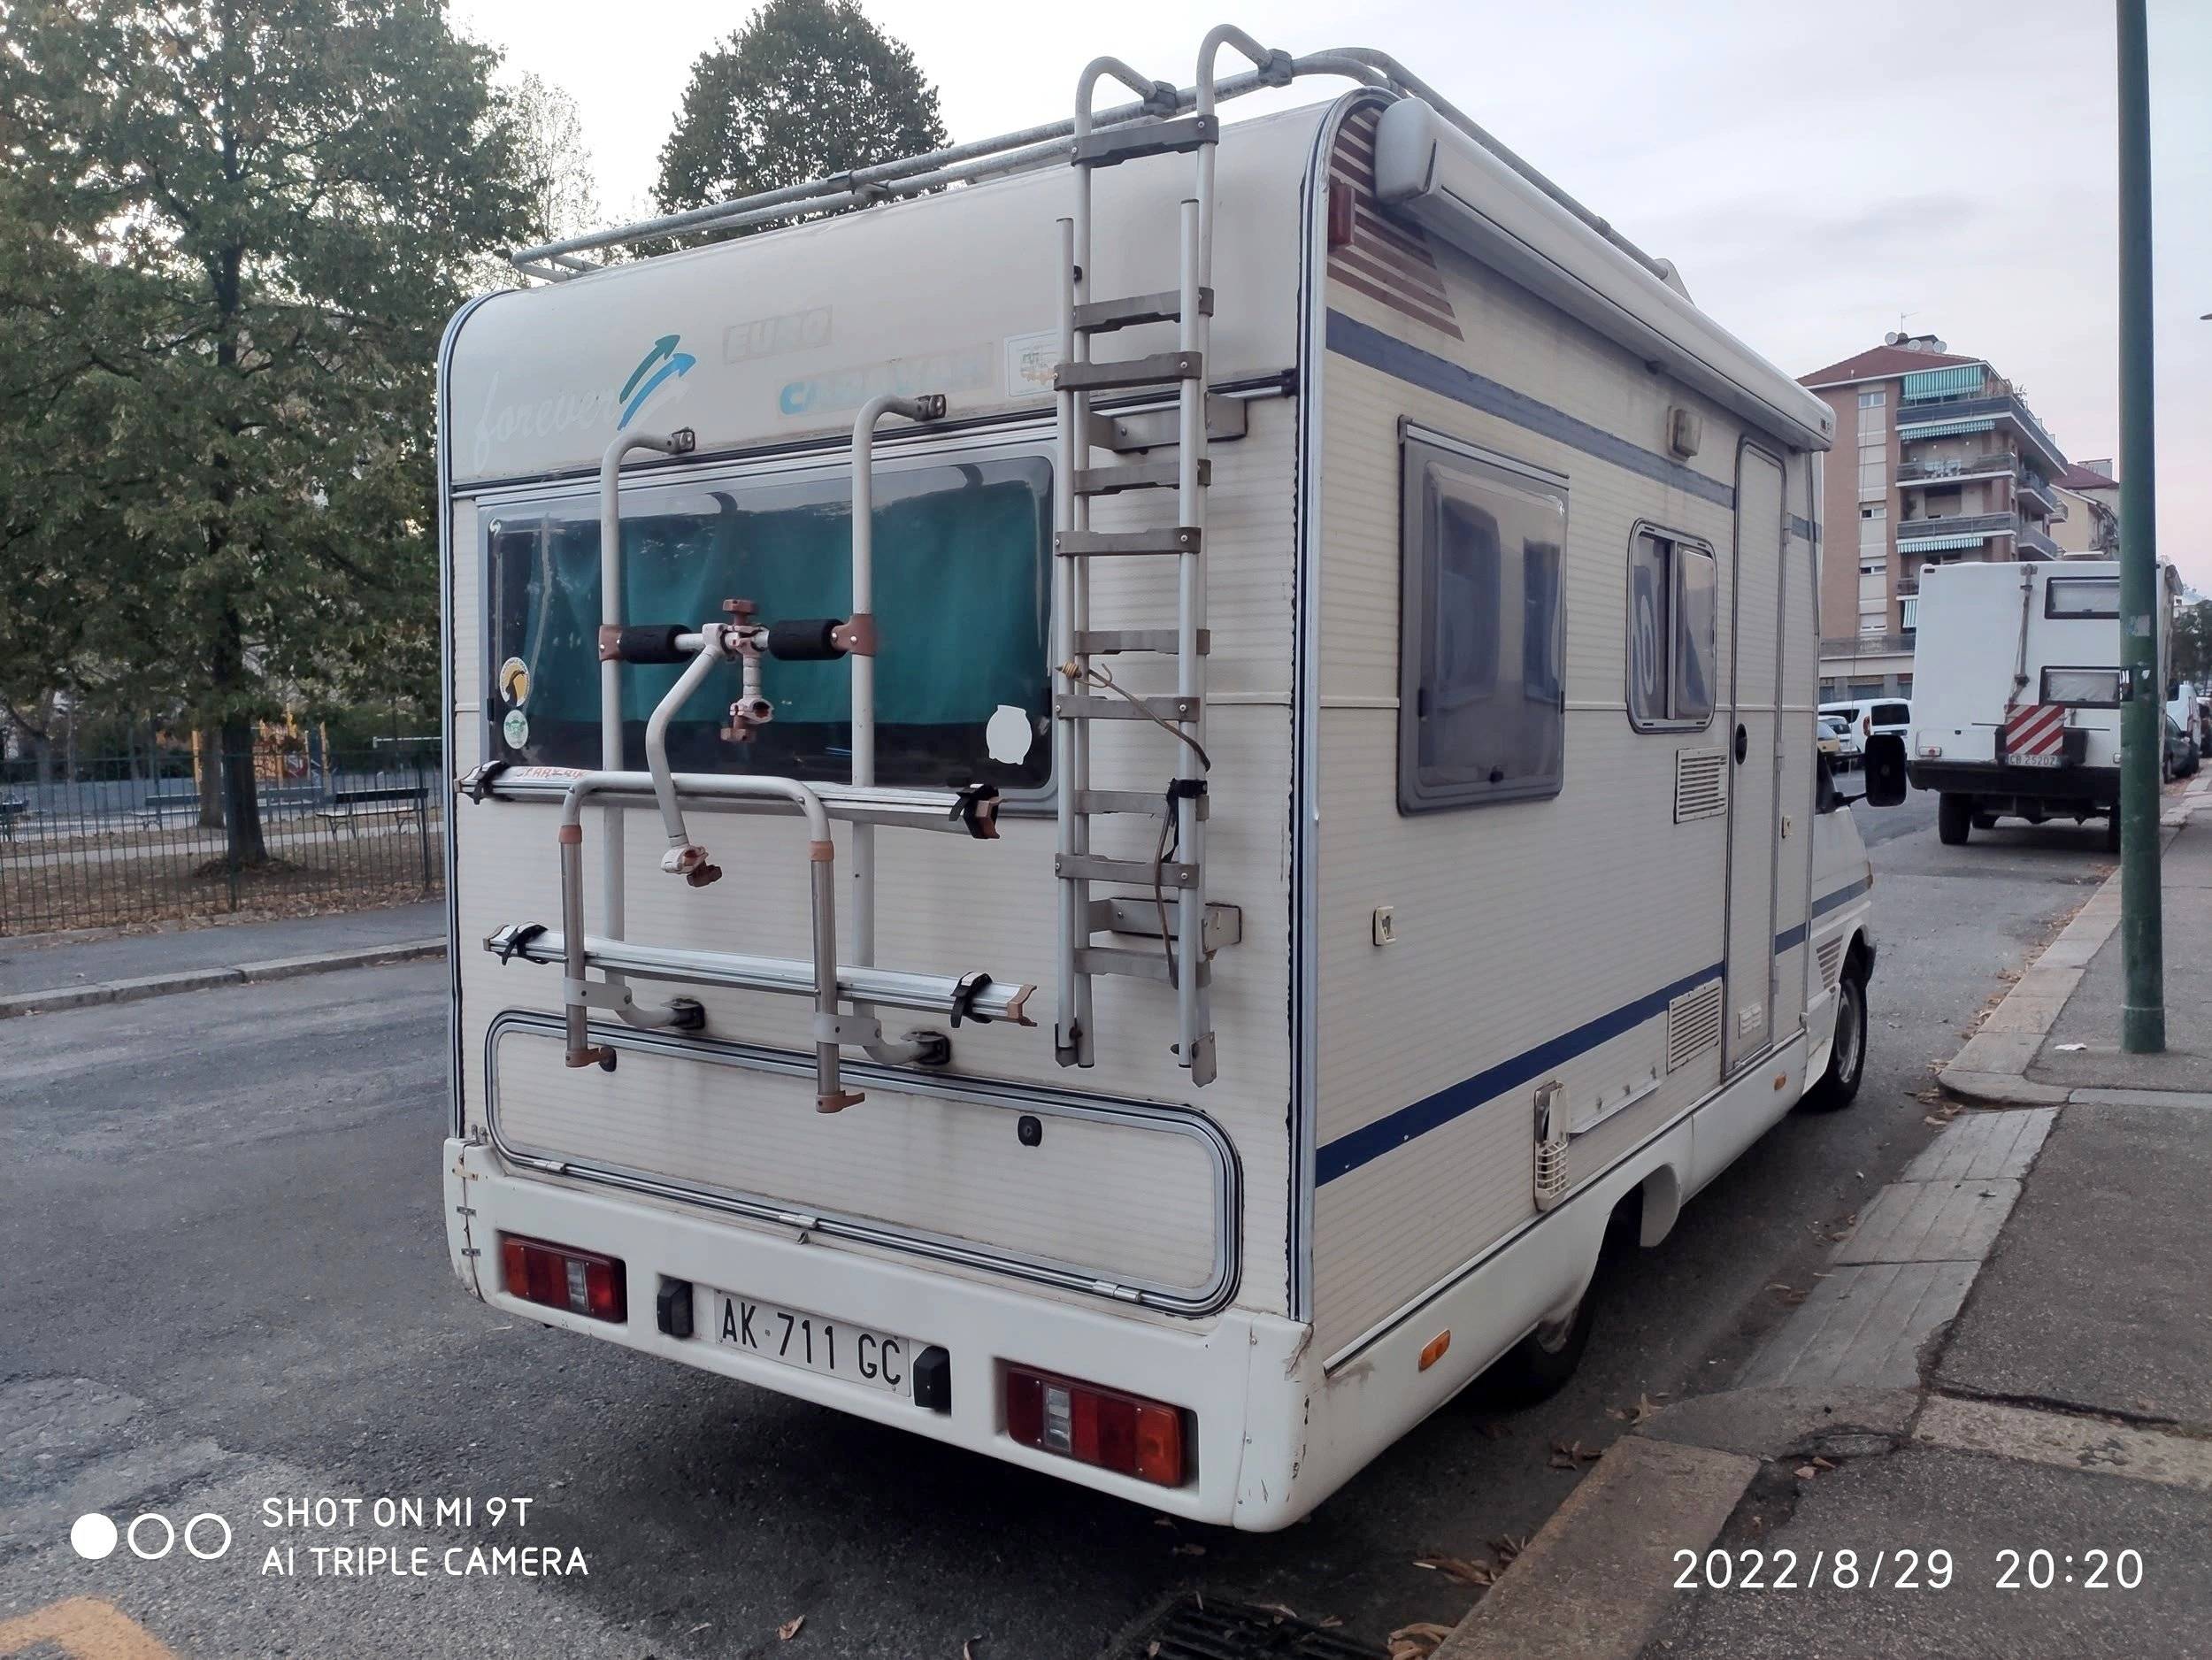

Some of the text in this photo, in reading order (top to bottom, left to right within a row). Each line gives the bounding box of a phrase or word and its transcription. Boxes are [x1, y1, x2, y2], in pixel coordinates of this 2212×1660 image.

[722, 1297, 902, 1386] AK 711 GC
